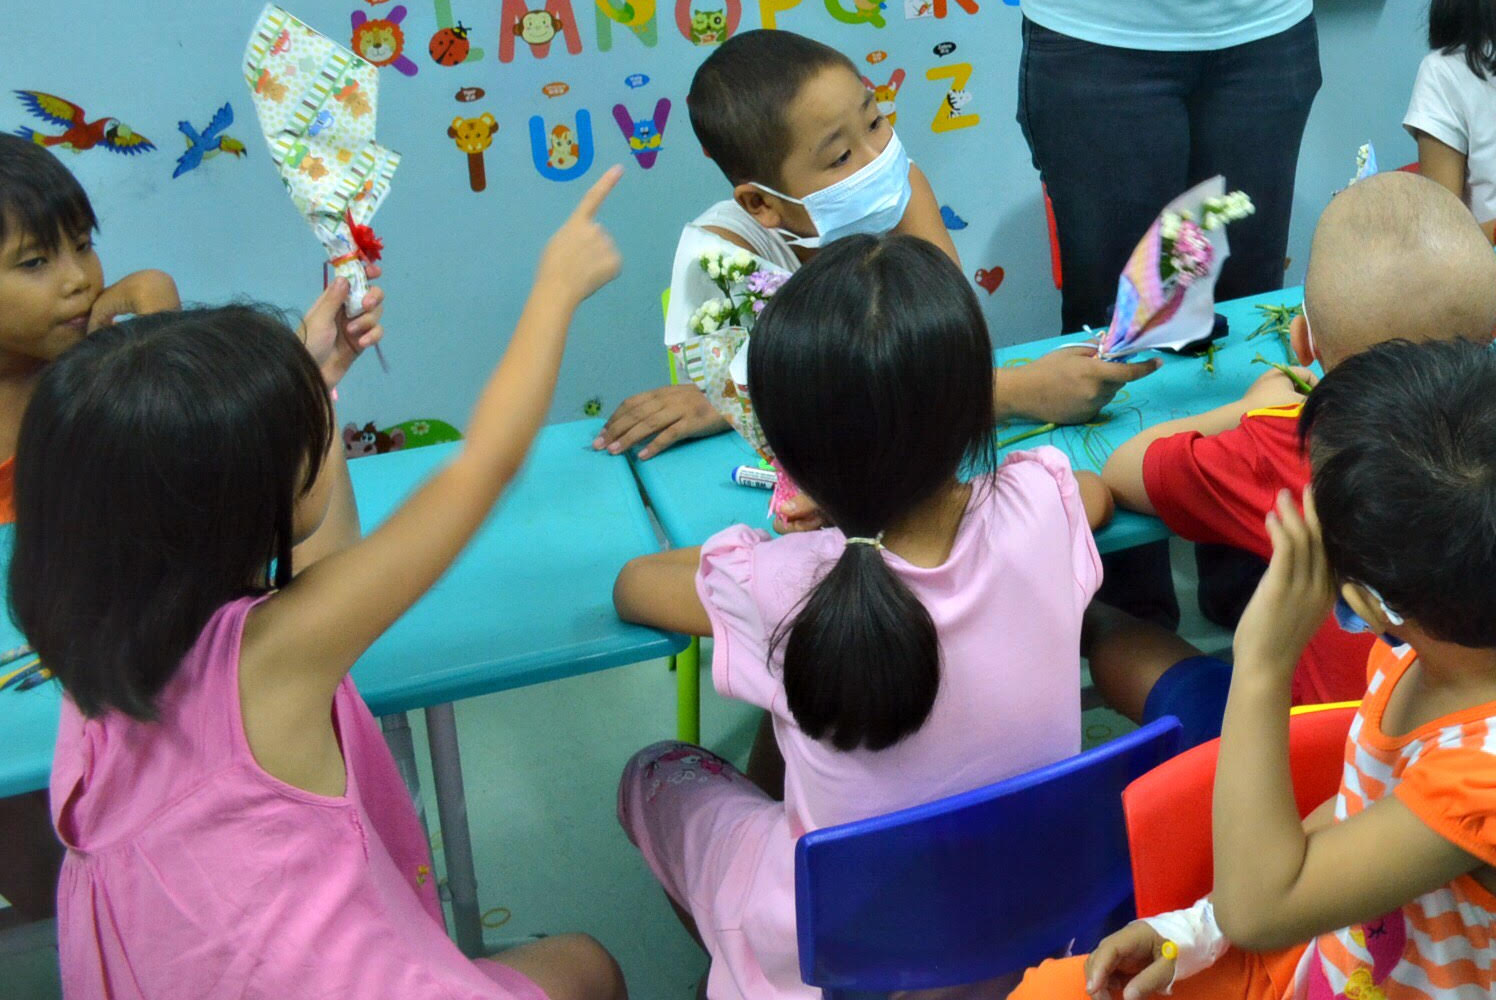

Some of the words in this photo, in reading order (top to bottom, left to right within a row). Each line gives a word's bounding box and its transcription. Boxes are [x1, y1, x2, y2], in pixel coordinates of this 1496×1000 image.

[529, 108, 595, 182] U
[612, 97, 672, 169] V
[926, 62, 980, 134] Z
